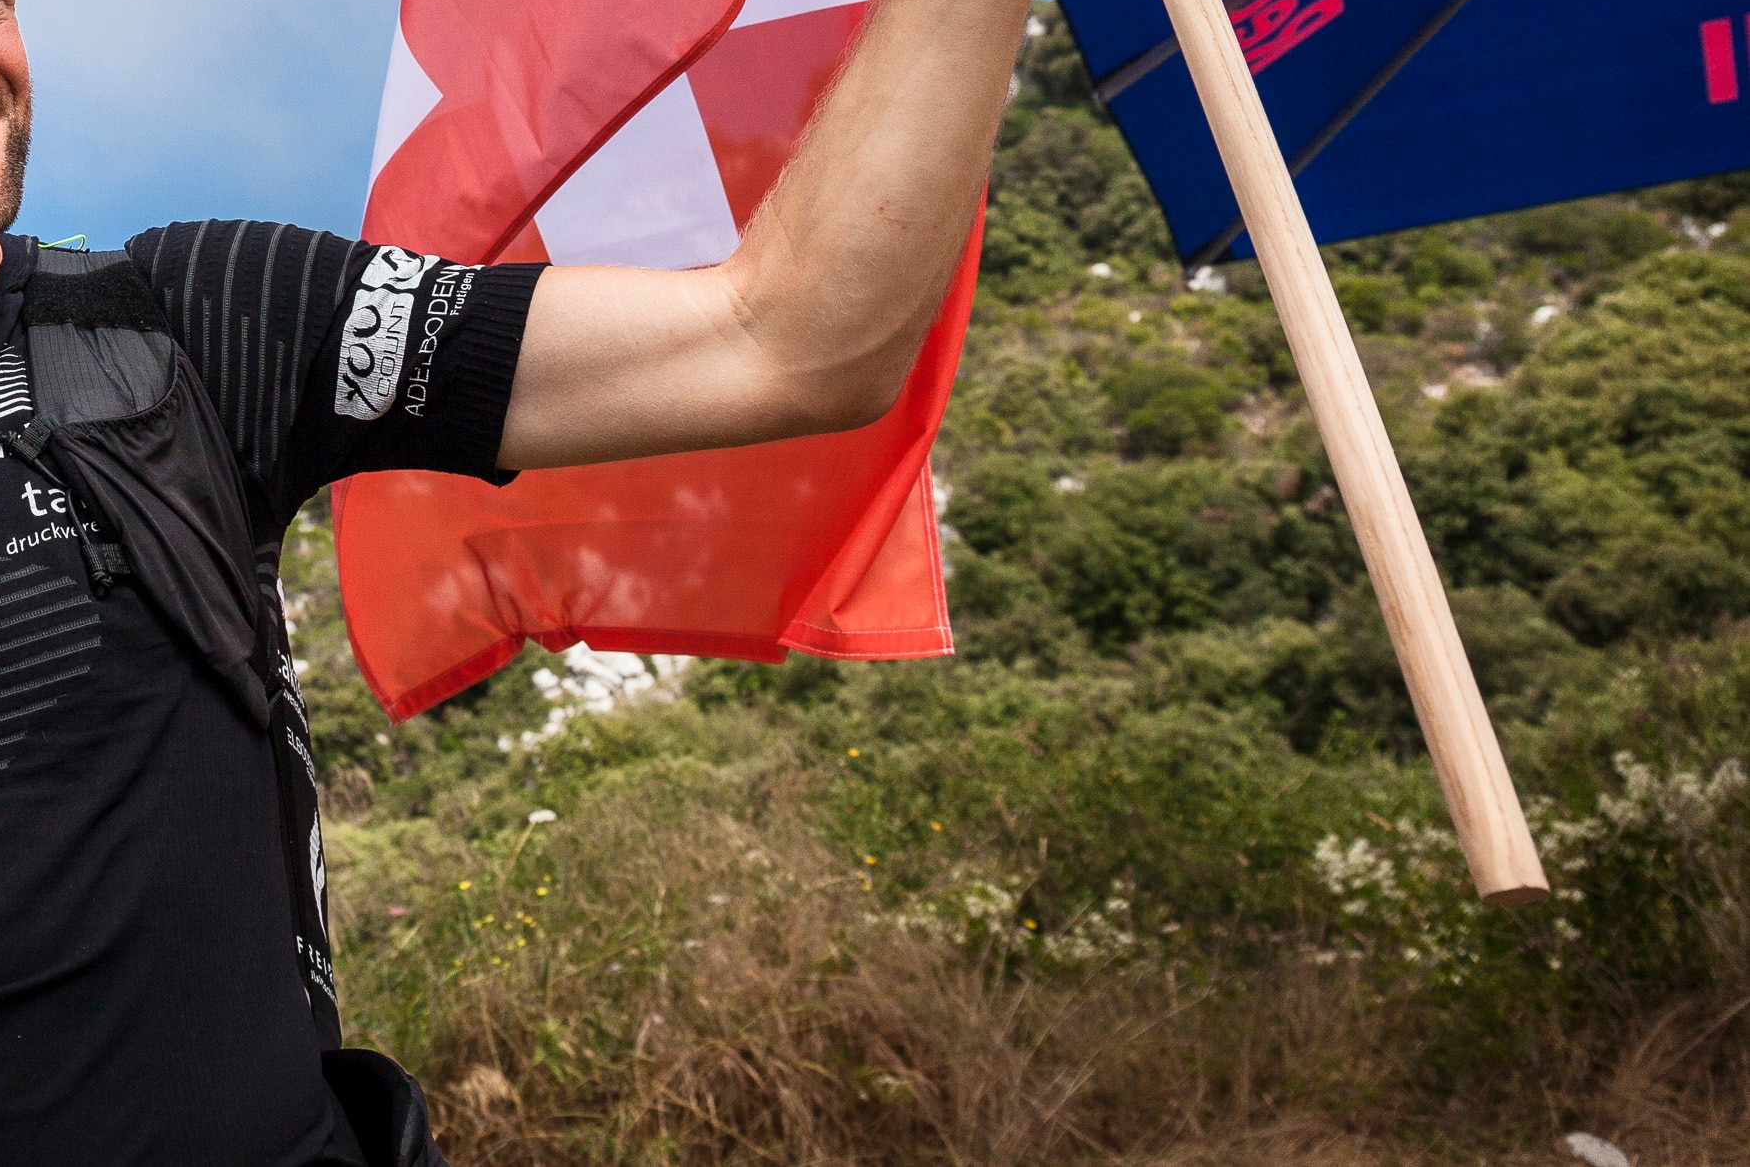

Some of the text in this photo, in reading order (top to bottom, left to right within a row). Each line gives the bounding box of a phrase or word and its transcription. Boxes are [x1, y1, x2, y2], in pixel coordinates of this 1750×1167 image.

[405, 265, 460, 416] ADELBODEN
[450, 273, 475, 316] Frutigen
[377, 301, 407, 397] COUNT
